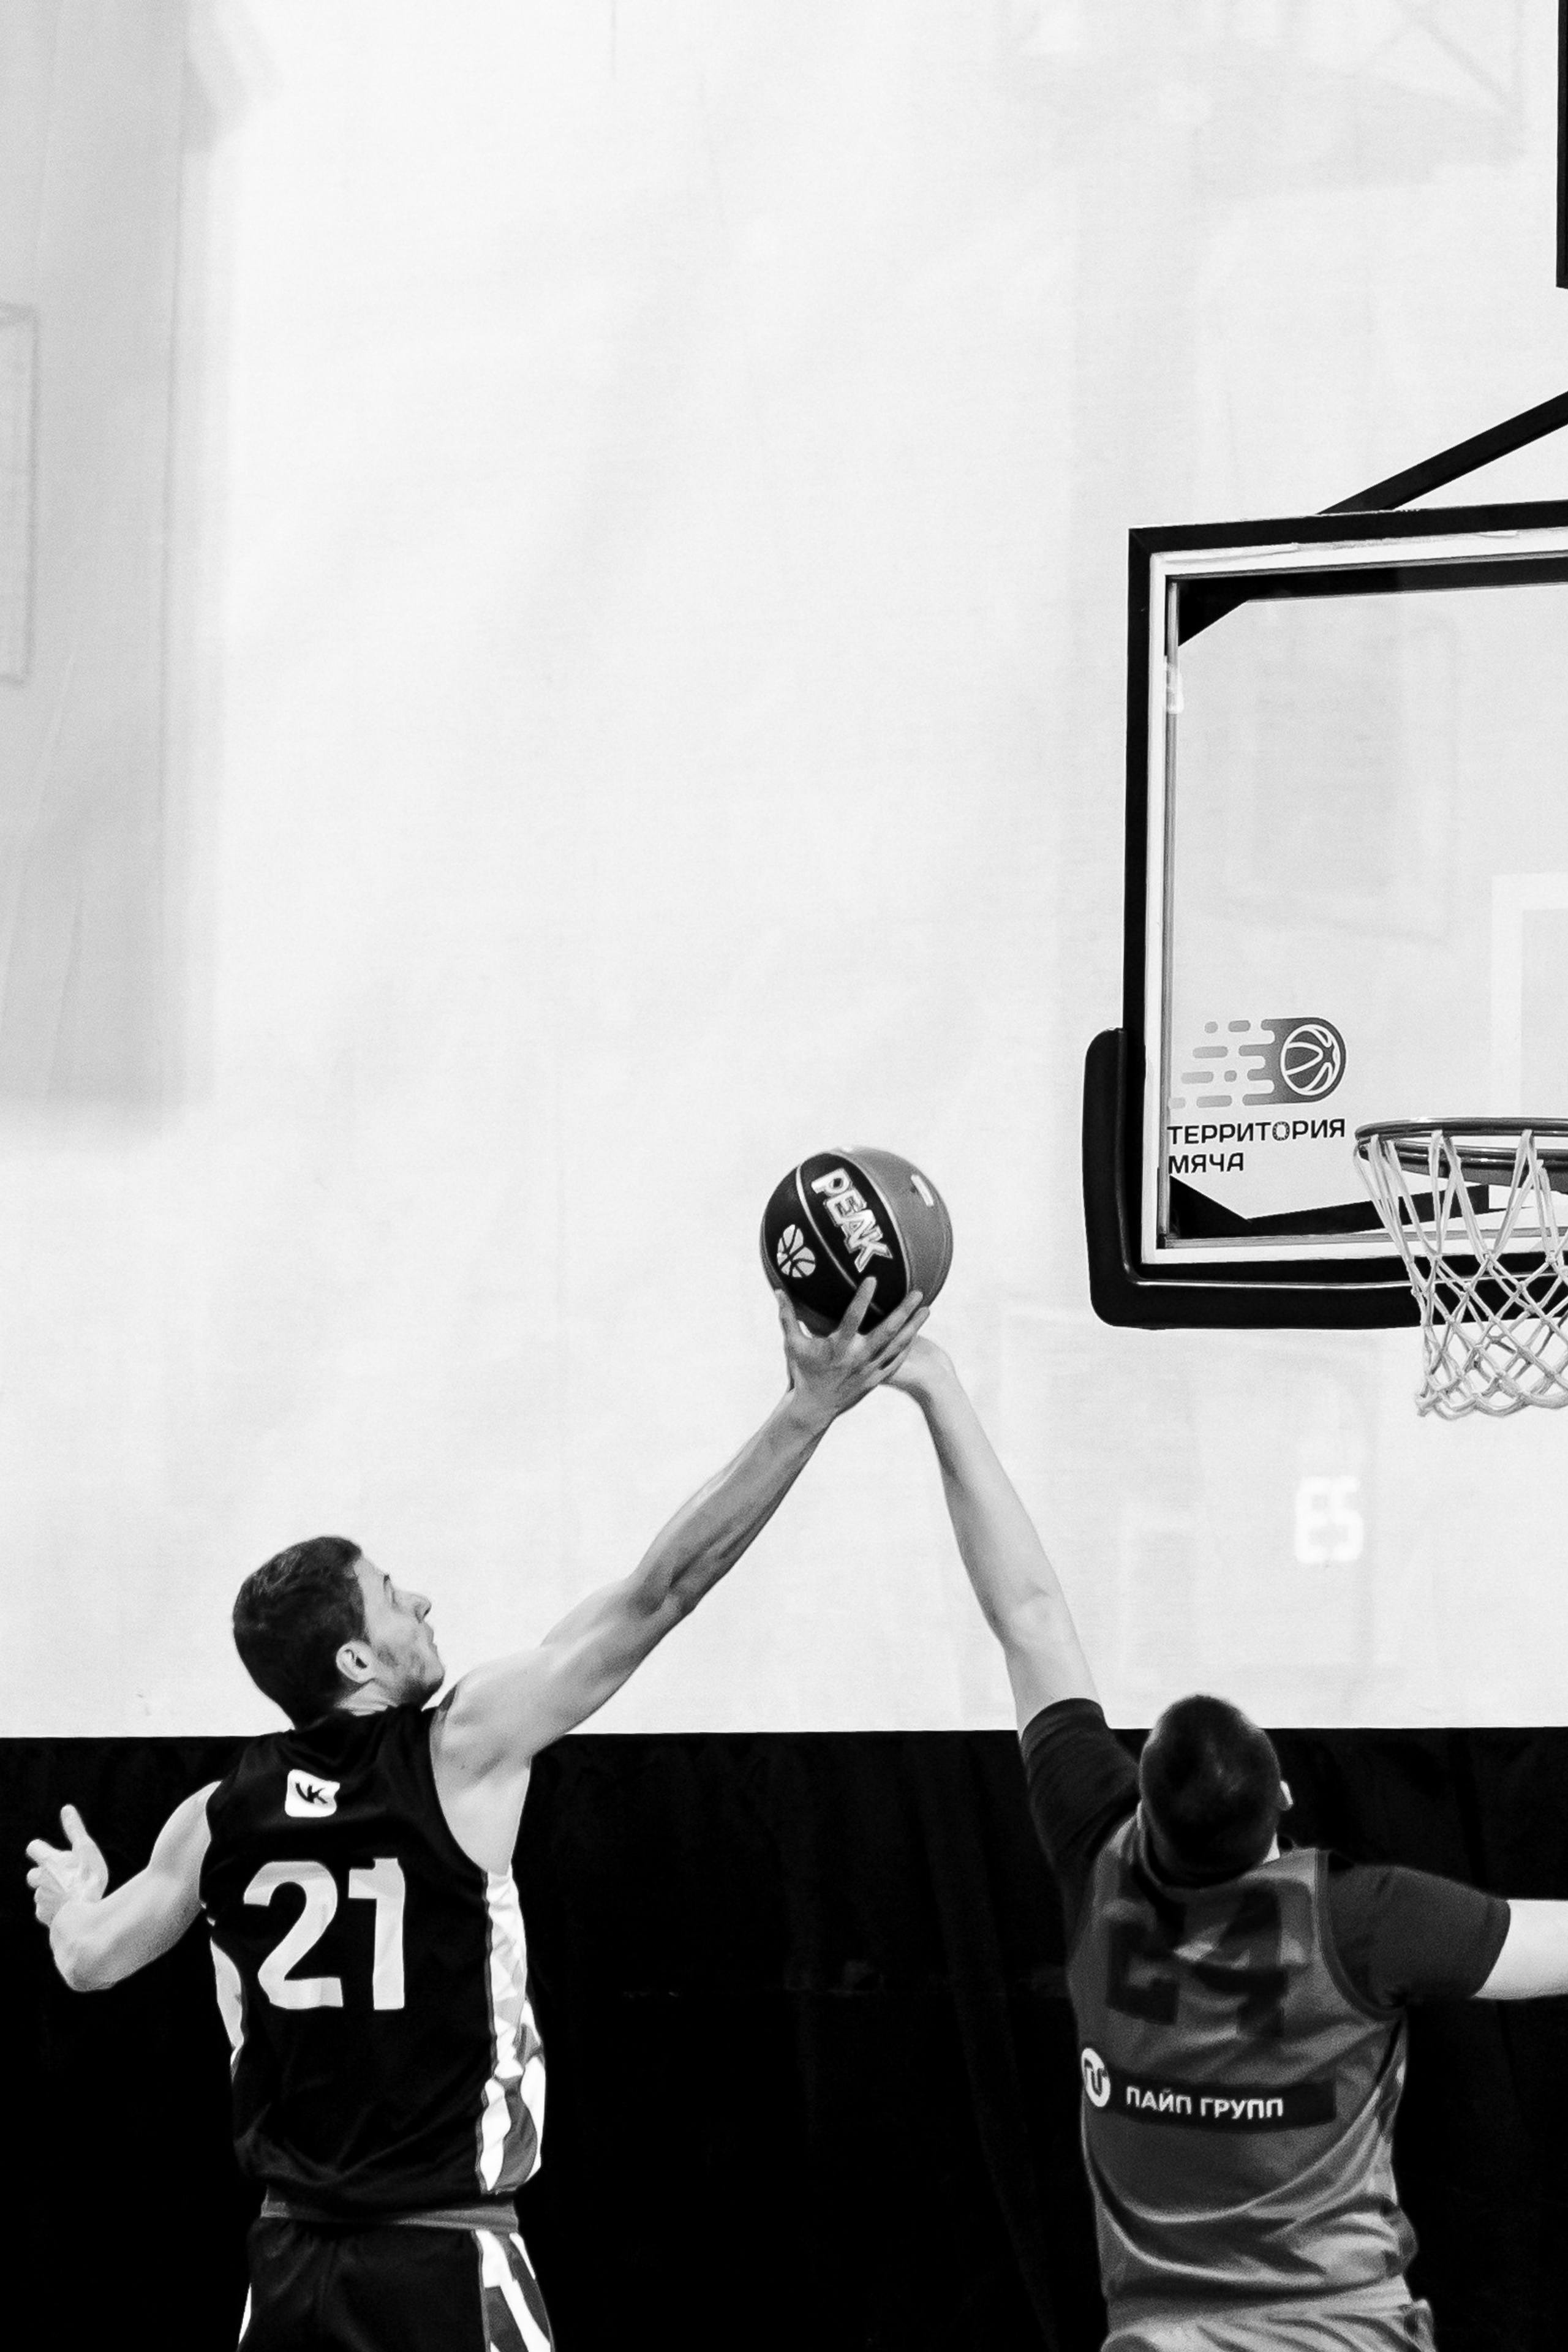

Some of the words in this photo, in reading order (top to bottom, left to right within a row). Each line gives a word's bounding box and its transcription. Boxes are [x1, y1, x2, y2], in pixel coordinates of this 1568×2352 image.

[1166, 1118, 1346, 1145] ТЕРРИТОРИЯ
[1167, 1152, 1244, 1175] МЯЧА
[810, 1166, 894, 1273] PEAK
[243, 1858, 405, 2010] 21
[1126, 2086, 1193, 2115] ПАЙП
[1200, 2097, 1284, 2120] ГРУПП
